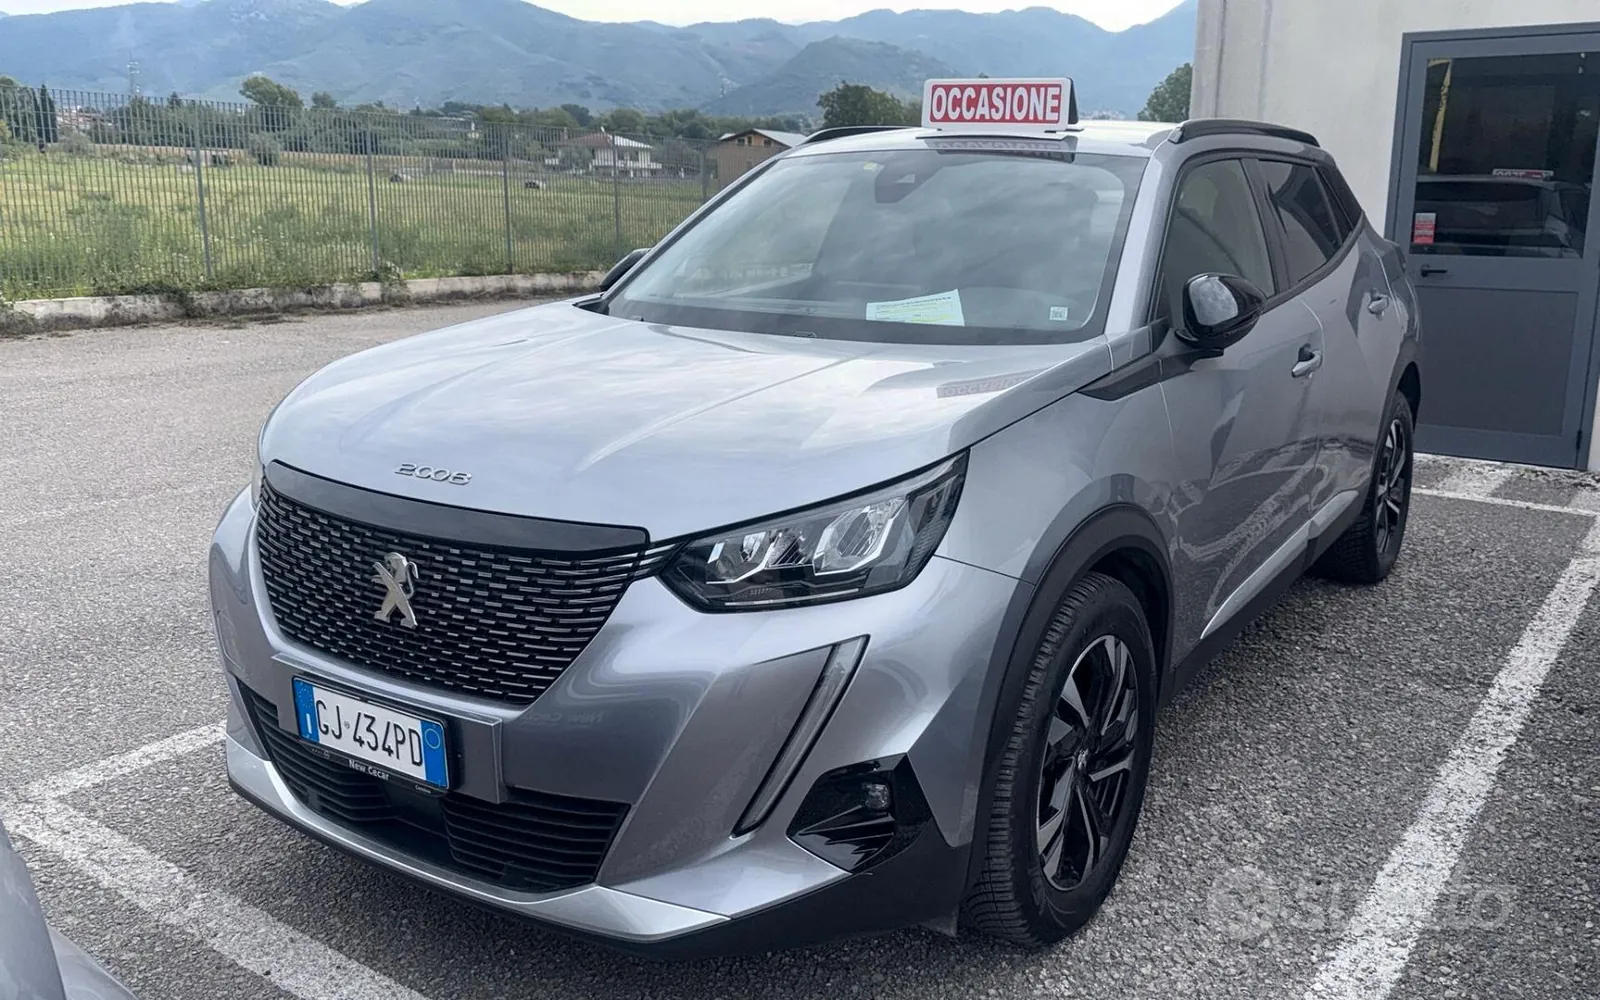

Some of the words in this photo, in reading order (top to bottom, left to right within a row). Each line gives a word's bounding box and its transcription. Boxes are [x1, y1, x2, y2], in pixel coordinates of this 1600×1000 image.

[932, 87, 1060, 121] OCCASIONE
[395, 463, 472, 486] 2008
[349, 760, 366, 773] New
[368, 766, 389, 781] Cecar
